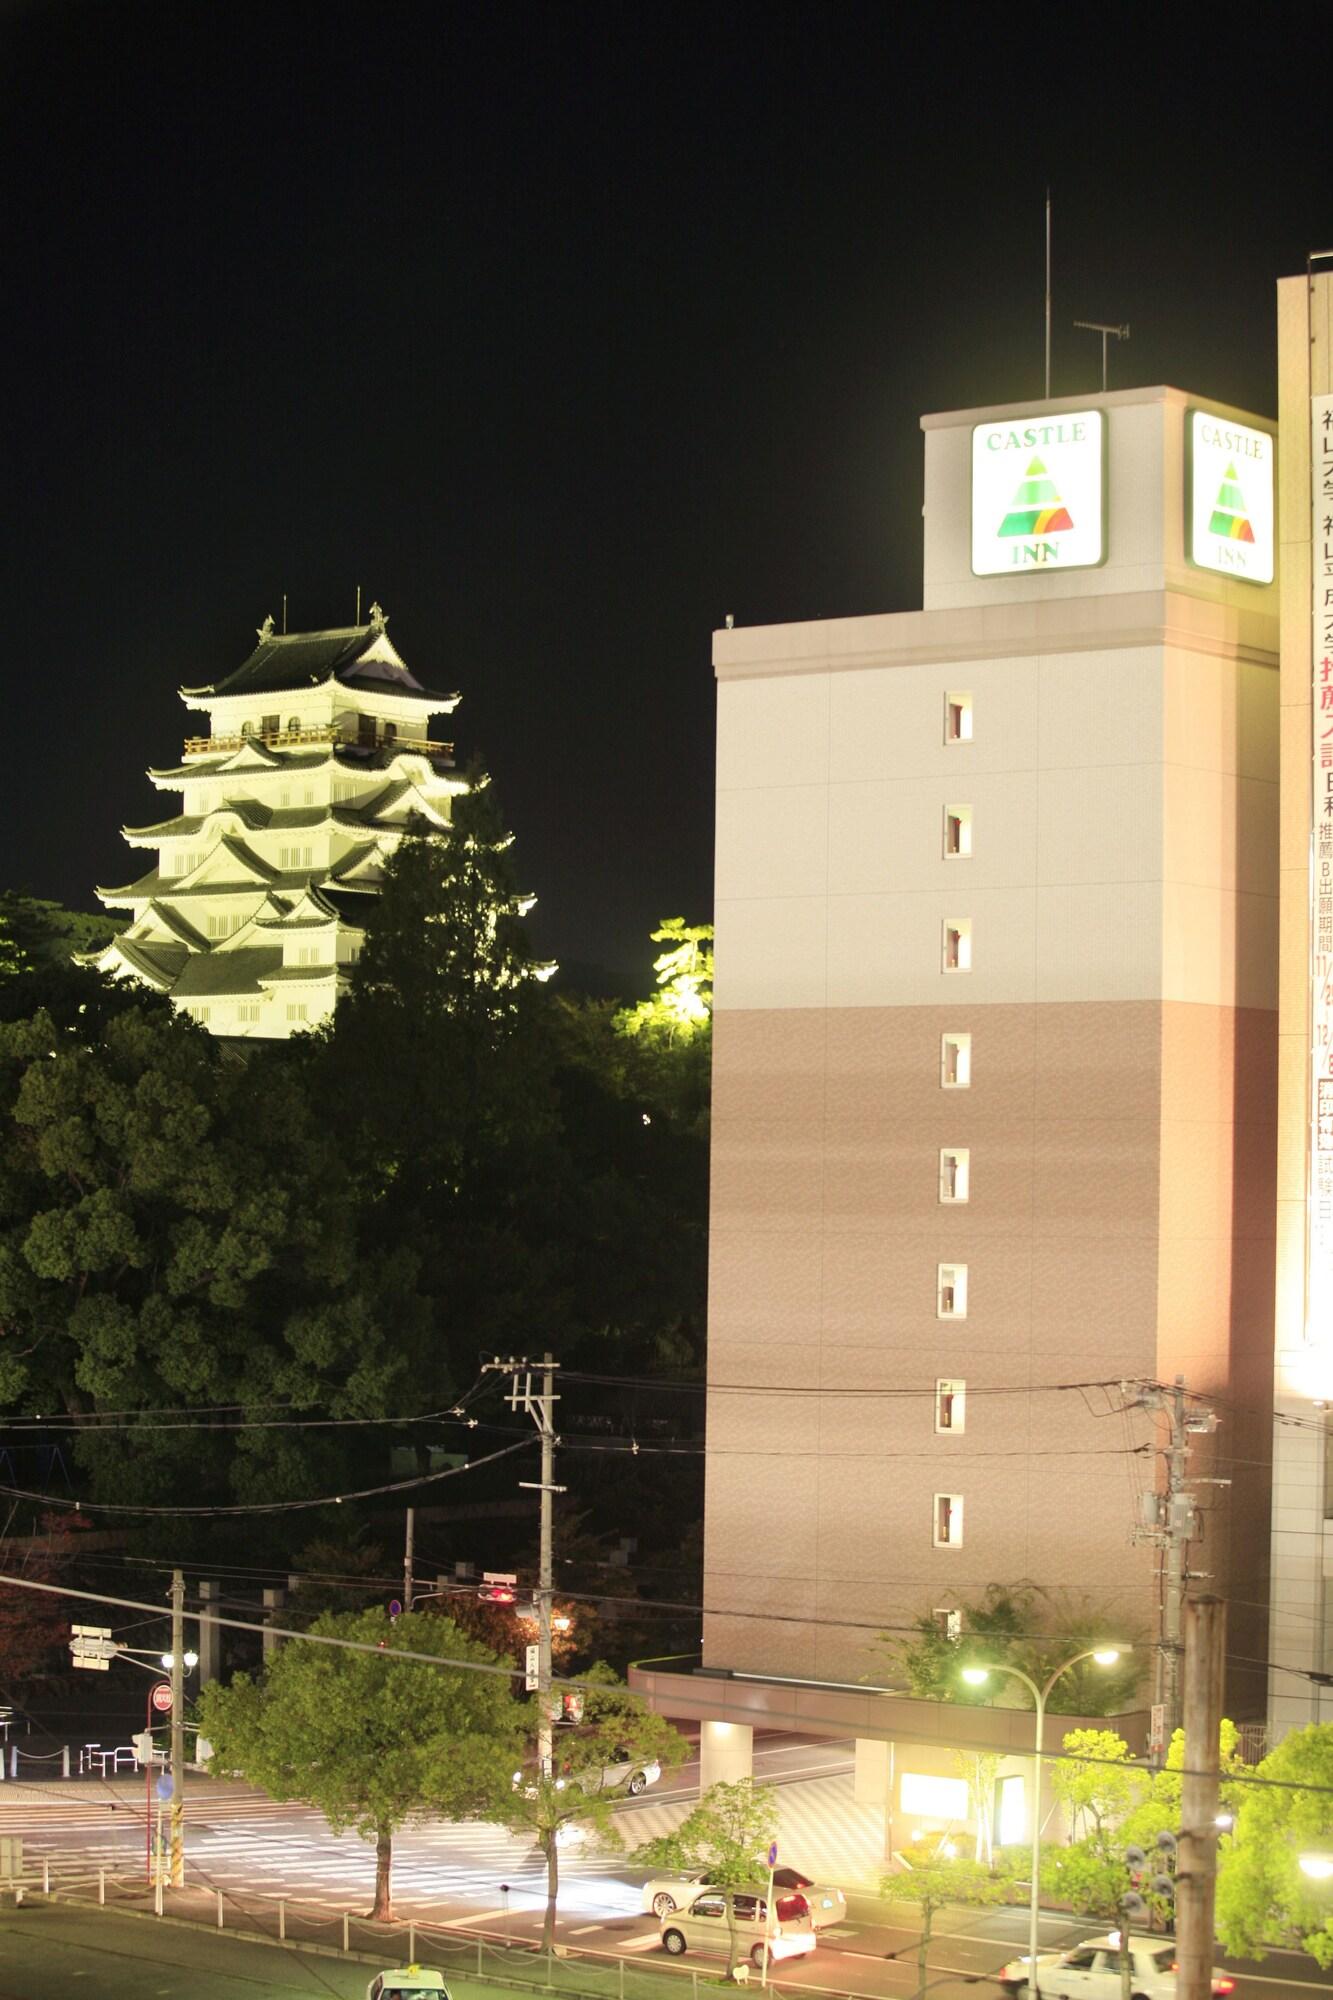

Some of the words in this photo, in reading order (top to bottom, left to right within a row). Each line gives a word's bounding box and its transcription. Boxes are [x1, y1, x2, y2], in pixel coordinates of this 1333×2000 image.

[986, 422, 1087, 451] CASTLE
[1200, 423, 1264, 460] CASTLE
[1012, 541, 1060, 565] INN
[1216, 545, 1248, 569] INN
